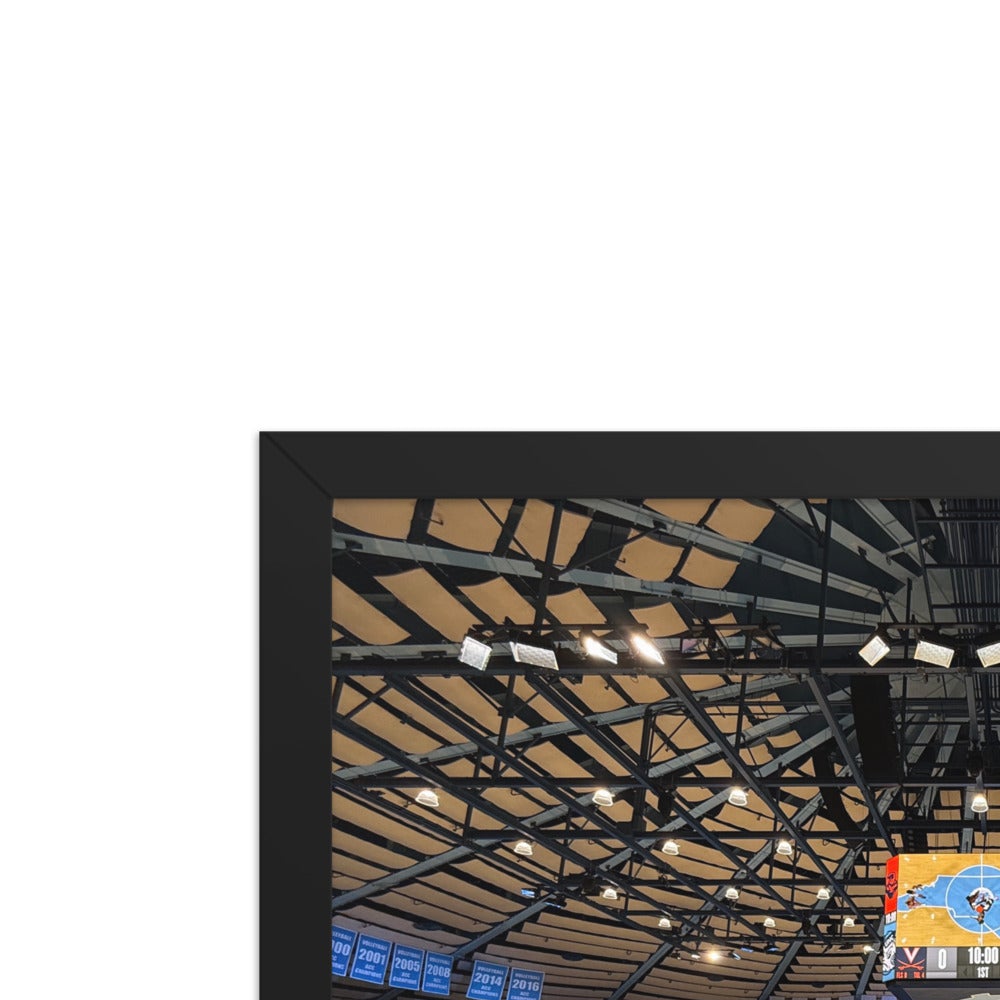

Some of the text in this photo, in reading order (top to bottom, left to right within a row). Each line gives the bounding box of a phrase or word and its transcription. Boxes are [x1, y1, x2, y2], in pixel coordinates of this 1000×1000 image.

[358, 948, 386, 966] 2001
[938, 948, 948, 969] 0
[967, 946, 999, 965] 10:00
[394, 957, 420, 972] 2005
[426, 964, 451, 978] 2008
[473, 972, 503, 987] 2014
[977, 967, 990, 978] 1ST
[512, 979, 540, 992] 2016
